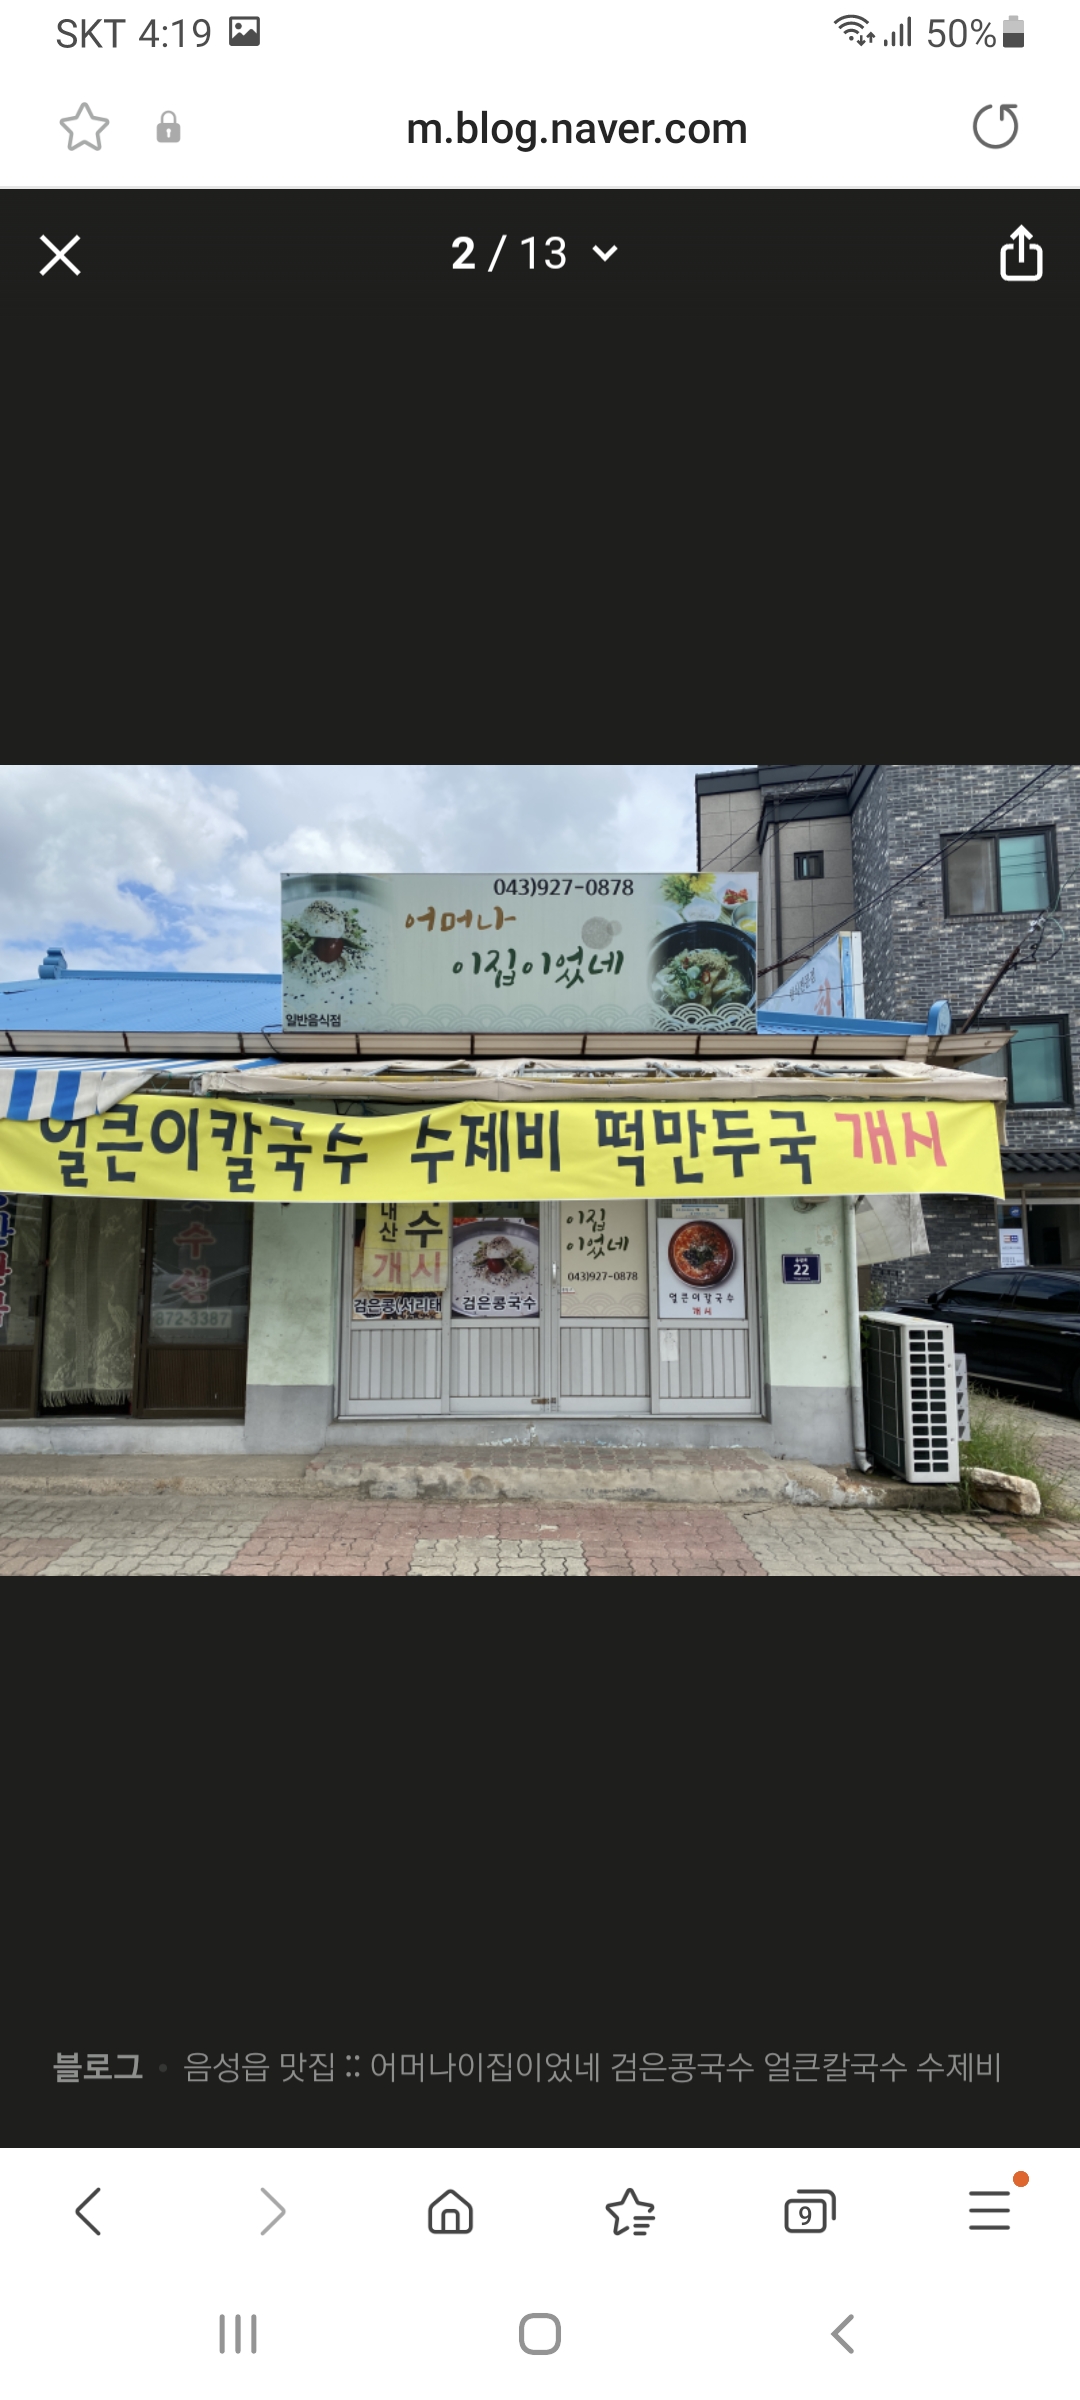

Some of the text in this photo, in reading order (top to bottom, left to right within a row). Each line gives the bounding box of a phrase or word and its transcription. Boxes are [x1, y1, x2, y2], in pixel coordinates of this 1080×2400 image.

[57, 19, 210, 48] SKT 4:19
[928, 19, 996, 47] 50%
[409, 111, 746, 152] m.blog.naver.com
[452, 236, 475, 269] 2
[521, 236, 566, 269] 13
[493, 878, 634, 897] 043)927-0878
[405, 906, 517, 932] 어머나
[452, 946, 624, 989] 이집이었네
[285, 1012, 342, 1028] 일반음식점
[40, 1104, 947, 1192] 얼큰이칼국수 수제비 떡만두국 개시
[566, 1208, 606, 1232] 이집
[566, 1234, 629, 1259] 이었네
[373, 1251, 441, 1284] 개시
[567, 1271, 638, 1281] 043)927-0878
[793, 1264, 810, 1276] 22
[463, 1296, 537, 1311] 검은콩국수
[155, 1311, 228, 1326] 872-3387
[53, 2052, 143, 2082] 블로그
[184, 2053, 269, 2083] 음성읍
[281, 2052, 333, 2082] 맛집
[371, 2053, 599, 2082] 어머나이집이었네
[612, 2053, 754, 2083] 검은콩국수
[765, 2052, 907, 2082] 얼큰칼국수
[917, 2053, 999, 2082] 수제비
[799, 2206, 812, 2225] 9
